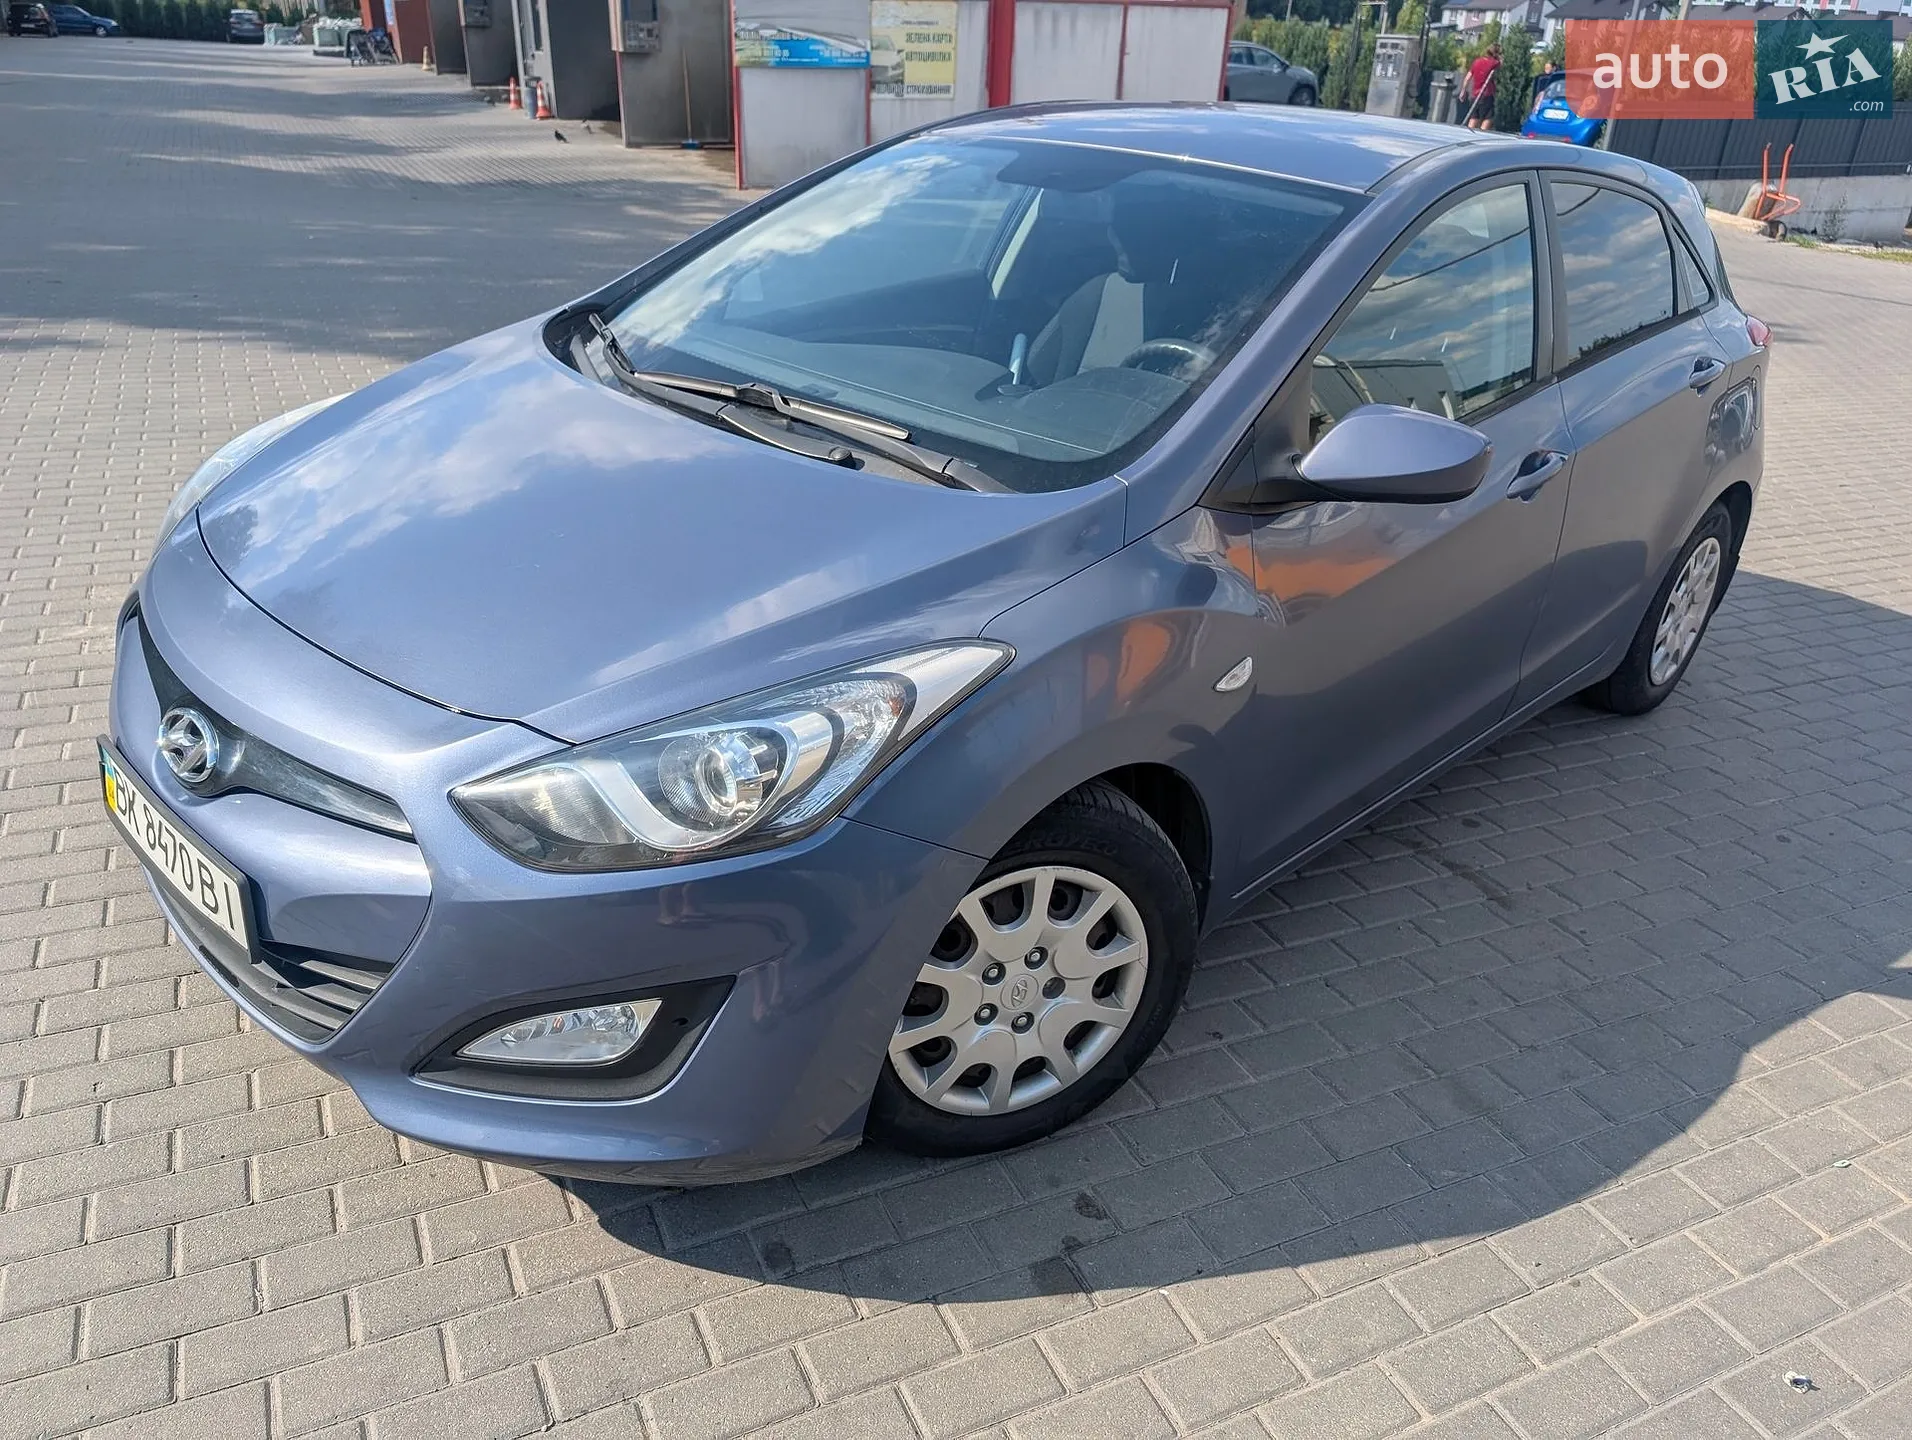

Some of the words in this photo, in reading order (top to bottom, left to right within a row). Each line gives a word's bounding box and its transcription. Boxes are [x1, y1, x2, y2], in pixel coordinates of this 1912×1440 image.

[905, 32, 931, 43] ЗЕЛЕНА
[933, 32, 953, 43] КАРТА
[114, 772, 140, 835] BK
[143, 803, 194, 892] 8470
[198, 858, 235, 930] BI
